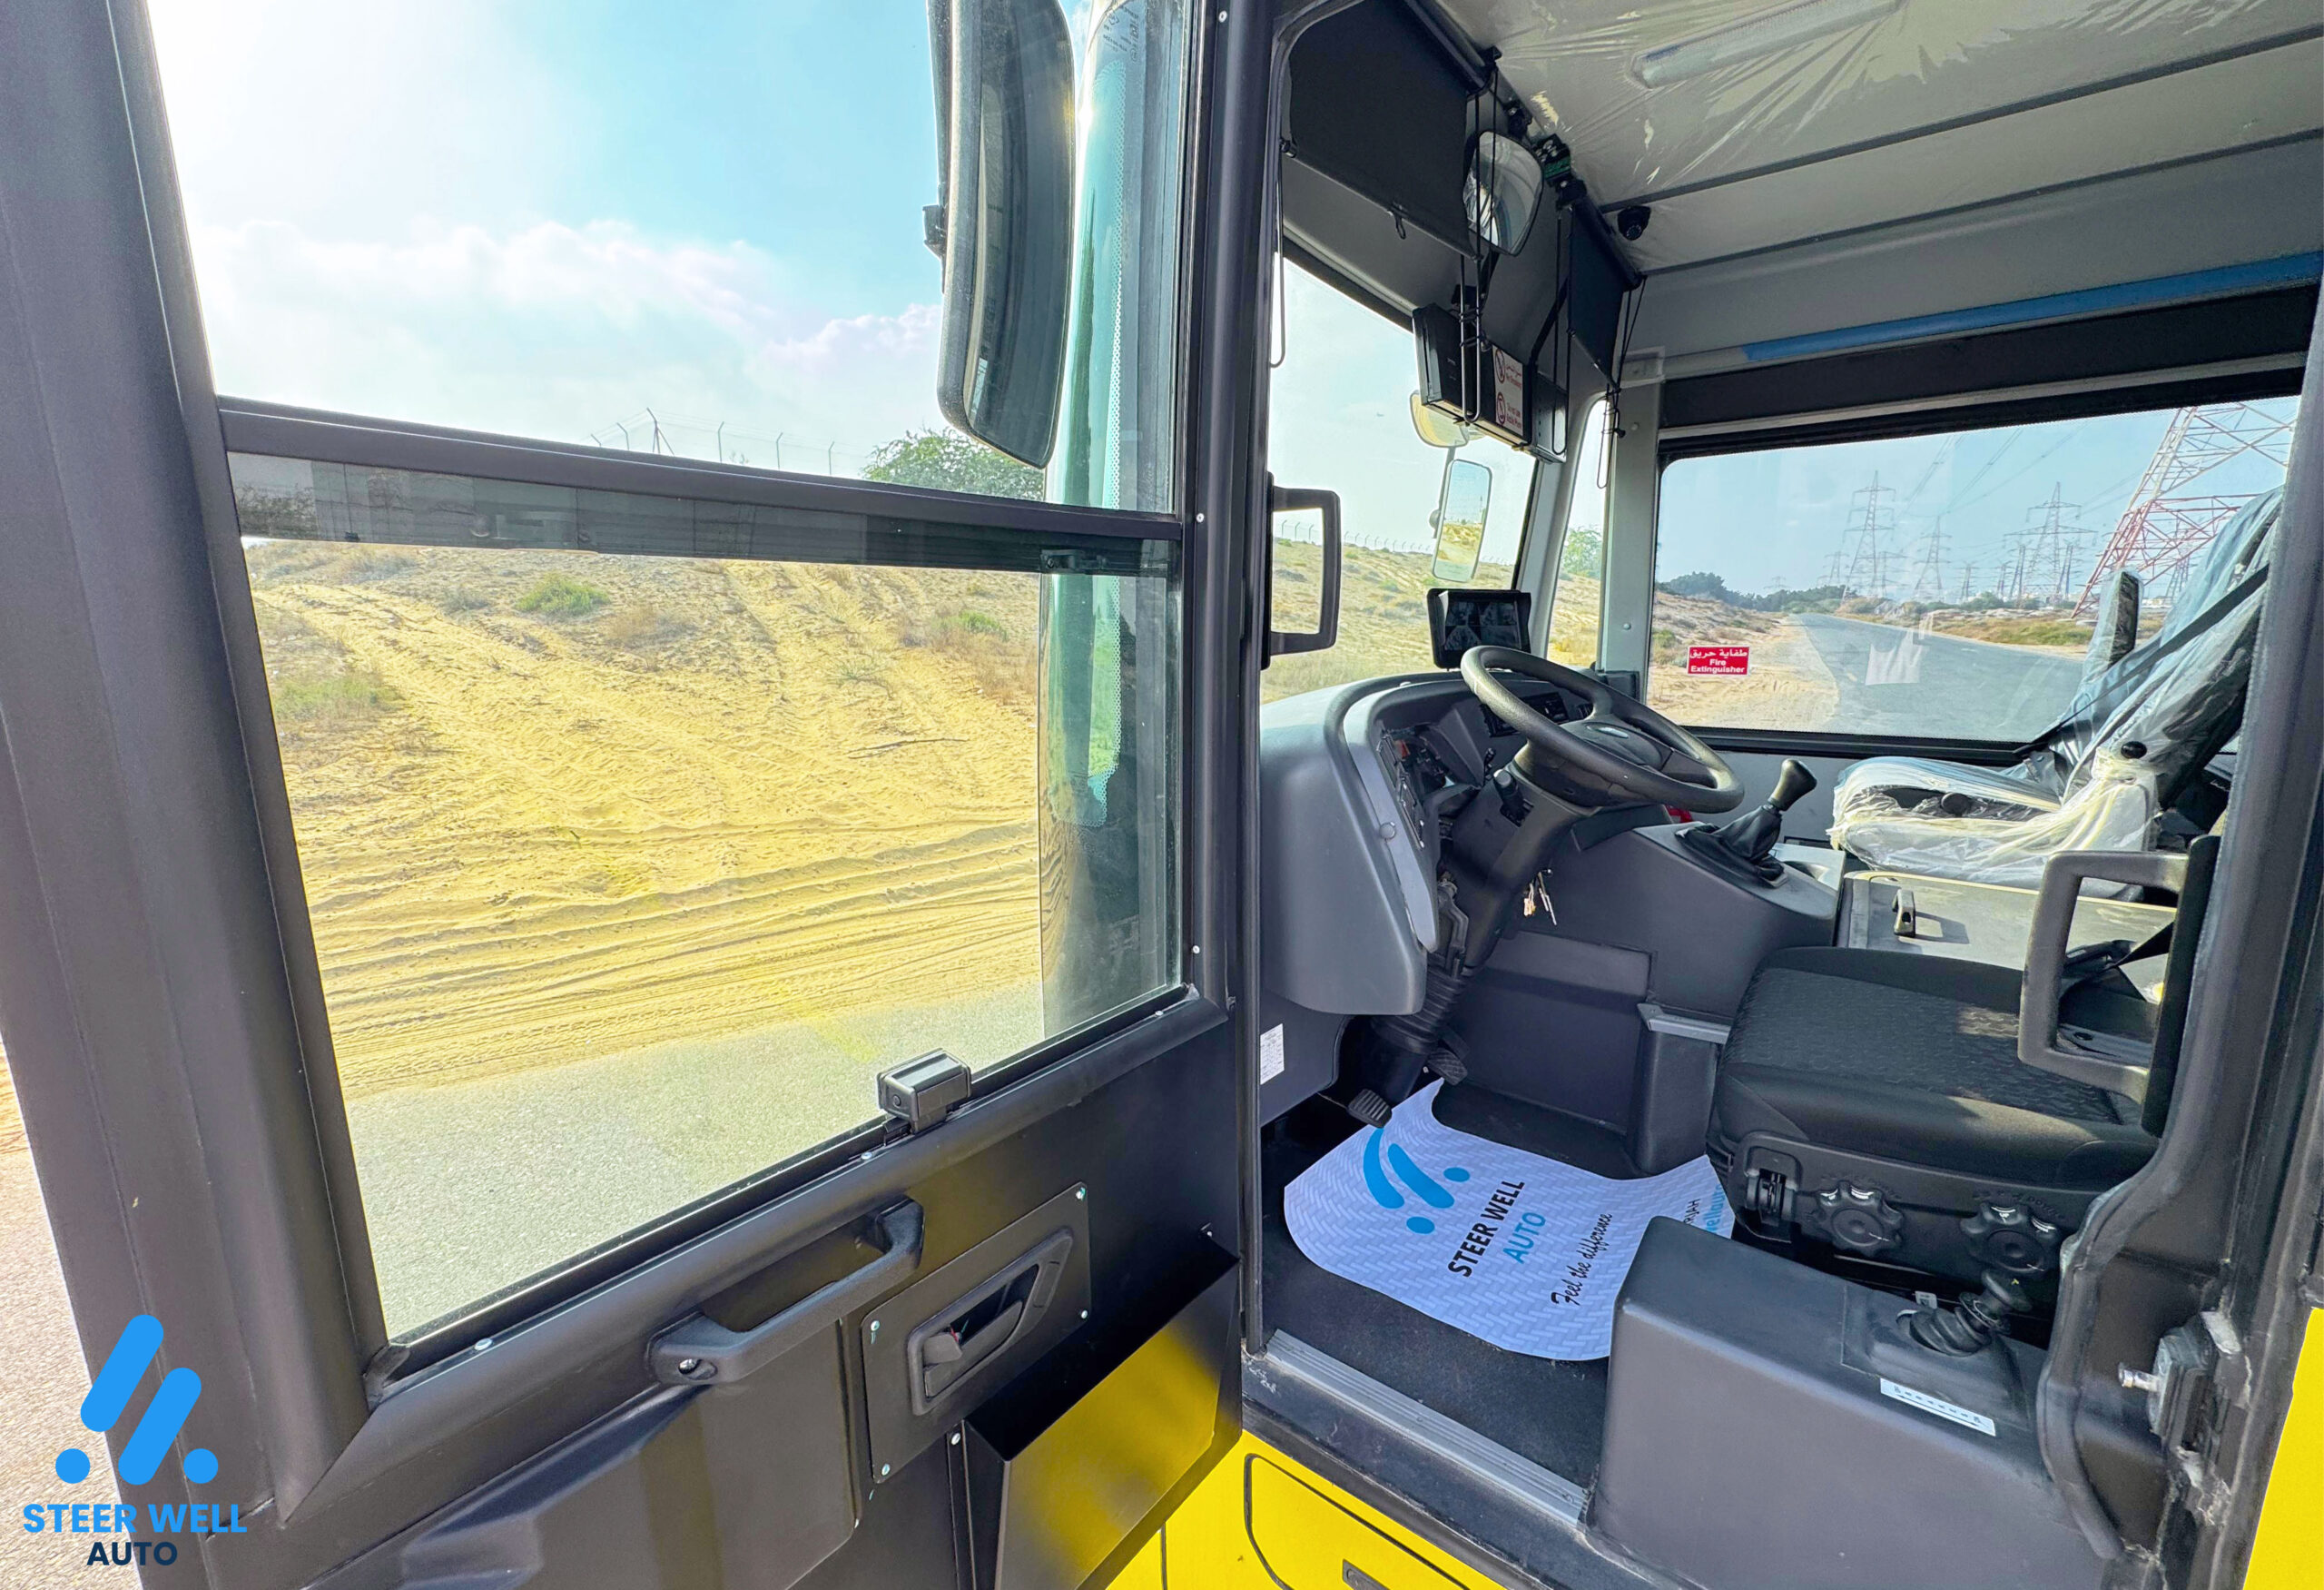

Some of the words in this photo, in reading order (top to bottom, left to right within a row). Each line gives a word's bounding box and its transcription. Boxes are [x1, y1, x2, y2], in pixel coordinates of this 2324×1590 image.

[1689, 649, 1717, 659] حريق
[1719, 649, 1748, 658] طفاية
[1690, 666, 1745, 674] Extinguisher
[1447, 1222, 1499, 1278] STEER
[1480, 1180, 1525, 1221] WELL
[1502, 1211, 1546, 1265] AUTO
[1576, 1213, 1613, 1259] difference
[1566, 1261, 1591, 1279] the
[1551, 1279, 1582, 1306] Feel
